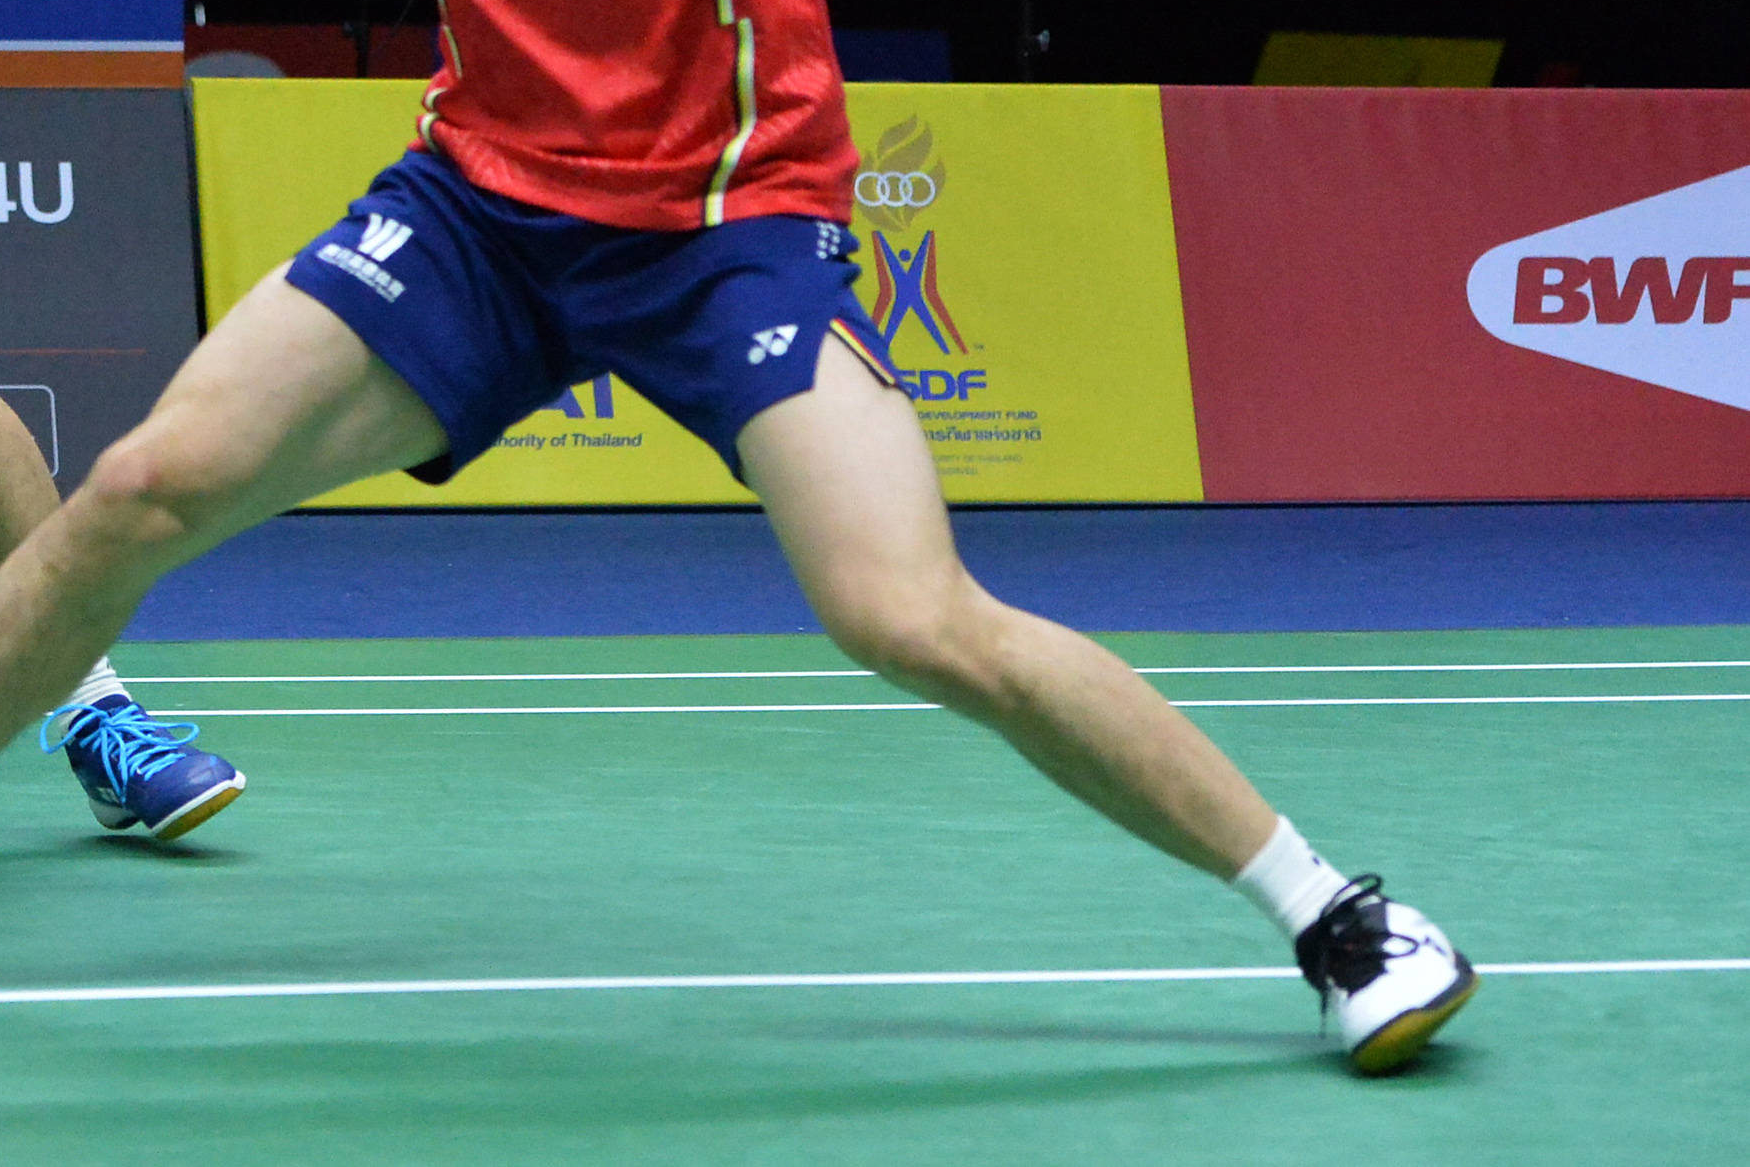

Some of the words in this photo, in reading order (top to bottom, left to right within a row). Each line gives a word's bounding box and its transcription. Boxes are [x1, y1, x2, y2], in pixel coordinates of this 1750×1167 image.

[917, 411, 1002, 420] DEVELOPMENT
[1005, 411, 1038, 420] FUND
[550, 433, 567, 447] of
[573, 433, 642, 447] Thailand
